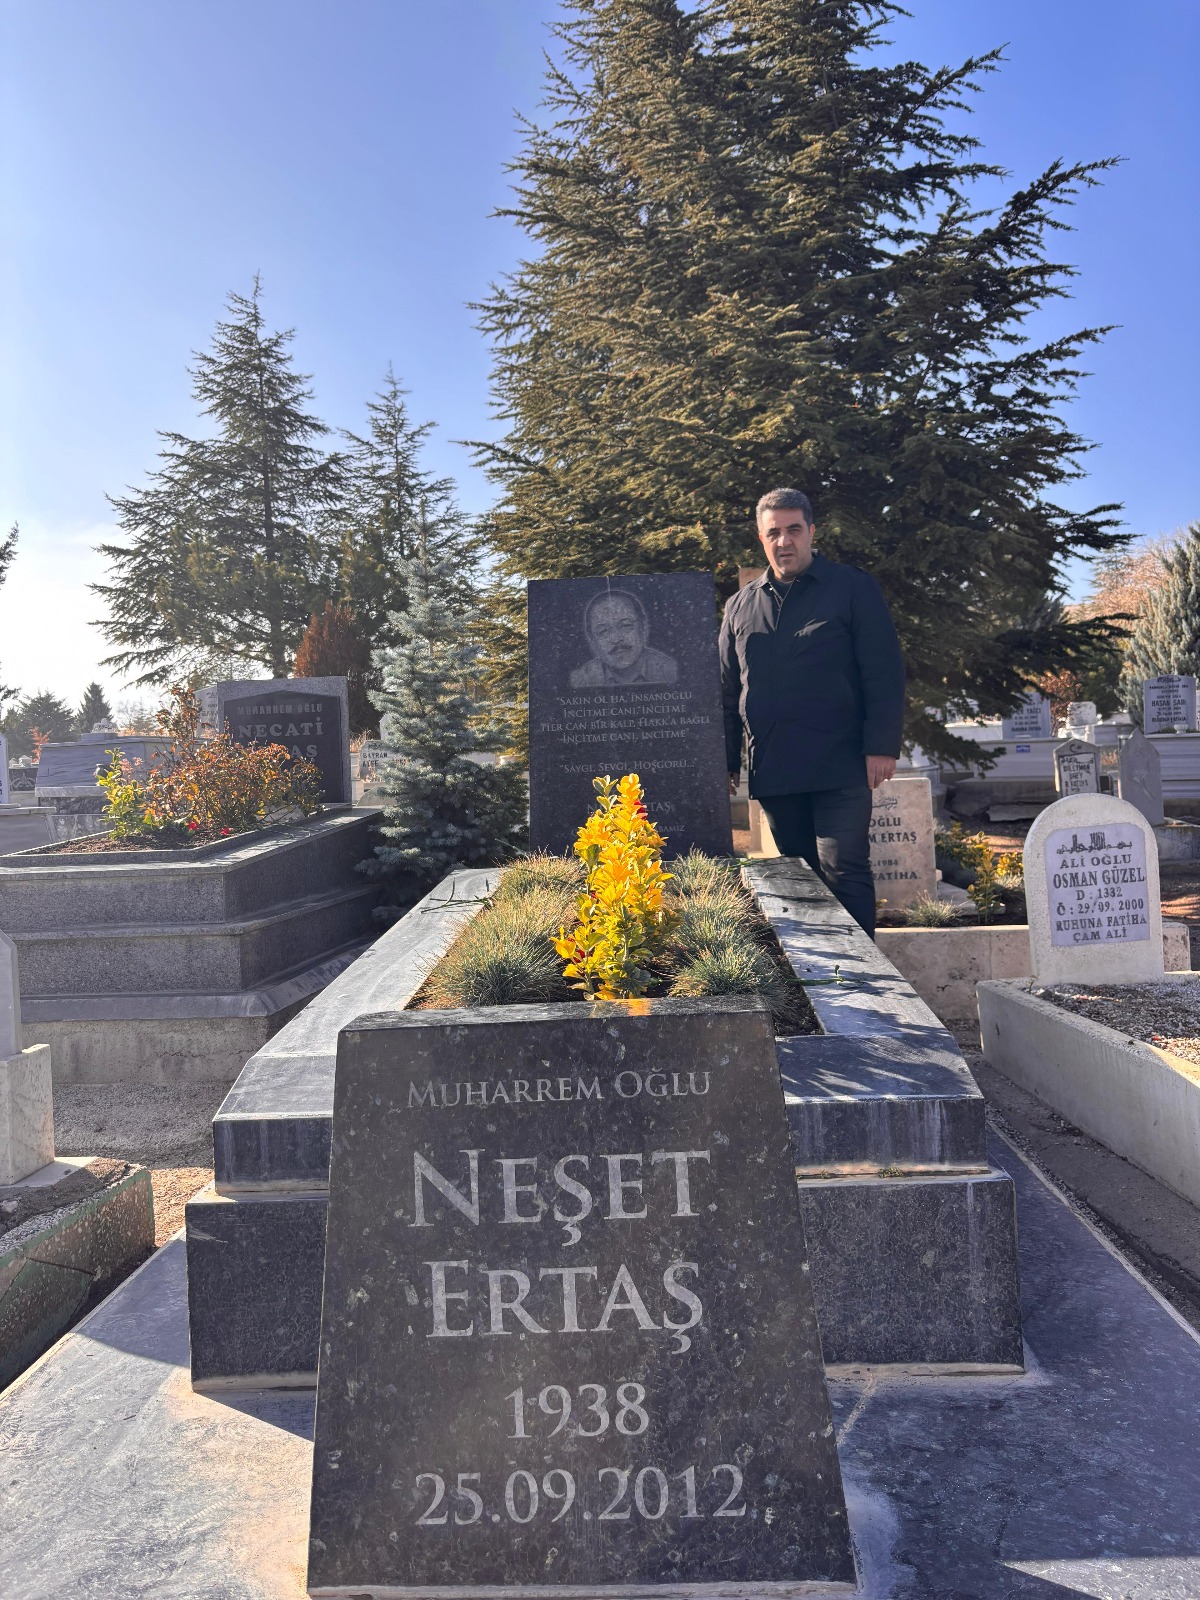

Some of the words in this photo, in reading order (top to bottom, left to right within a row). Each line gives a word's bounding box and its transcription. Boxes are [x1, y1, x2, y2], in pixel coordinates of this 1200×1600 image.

[594, 696, 608, 704] OL
[631, 691, 692, 702] İNSANOĞLU
[238, 704, 293, 715] MUHARREM
[297, 702, 323, 713] OĞLU
[563, 708, 608, 718] İNCİTME
[642, 704, 687, 715] İNCİTME
[238, 716, 324, 739] NECATİ
[566, 722, 587, 731] CAN
[591, 719, 608, 730] BİR
[680, 714, 710, 725] BAĞLI
[562, 733, 607, 744] İNCİTME
[869, 815, 901, 828] OĞLU
[881, 831, 917, 844] ERTAŞ
[1060, 855, 1086, 869] ALİ
[1091, 853, 1132, 866] OĞLU
[1053, 870, 1098, 889] OSMAN
[1102, 866, 1145, 885] GÜZEL
[1076, 890, 1085, 901] D
[1056, 917, 1104, 932] RUHUNA
[1107, 912, 1148, 927] FATİHA
[1073, 931, 1101, 943] ÇAM
[1105, 927, 1128, 939] ALİ
[408, 1076, 603, 1109] MUHARREM
[614, 1068, 711, 1100] OĞLU
[407, 1149, 711, 1247] NEŞET
[424, 1259, 704, 1355] ERTAŞ
[505, 1382, 650, 1439] 1938
[415, 1464, 747, 1526] 25.09.2012
